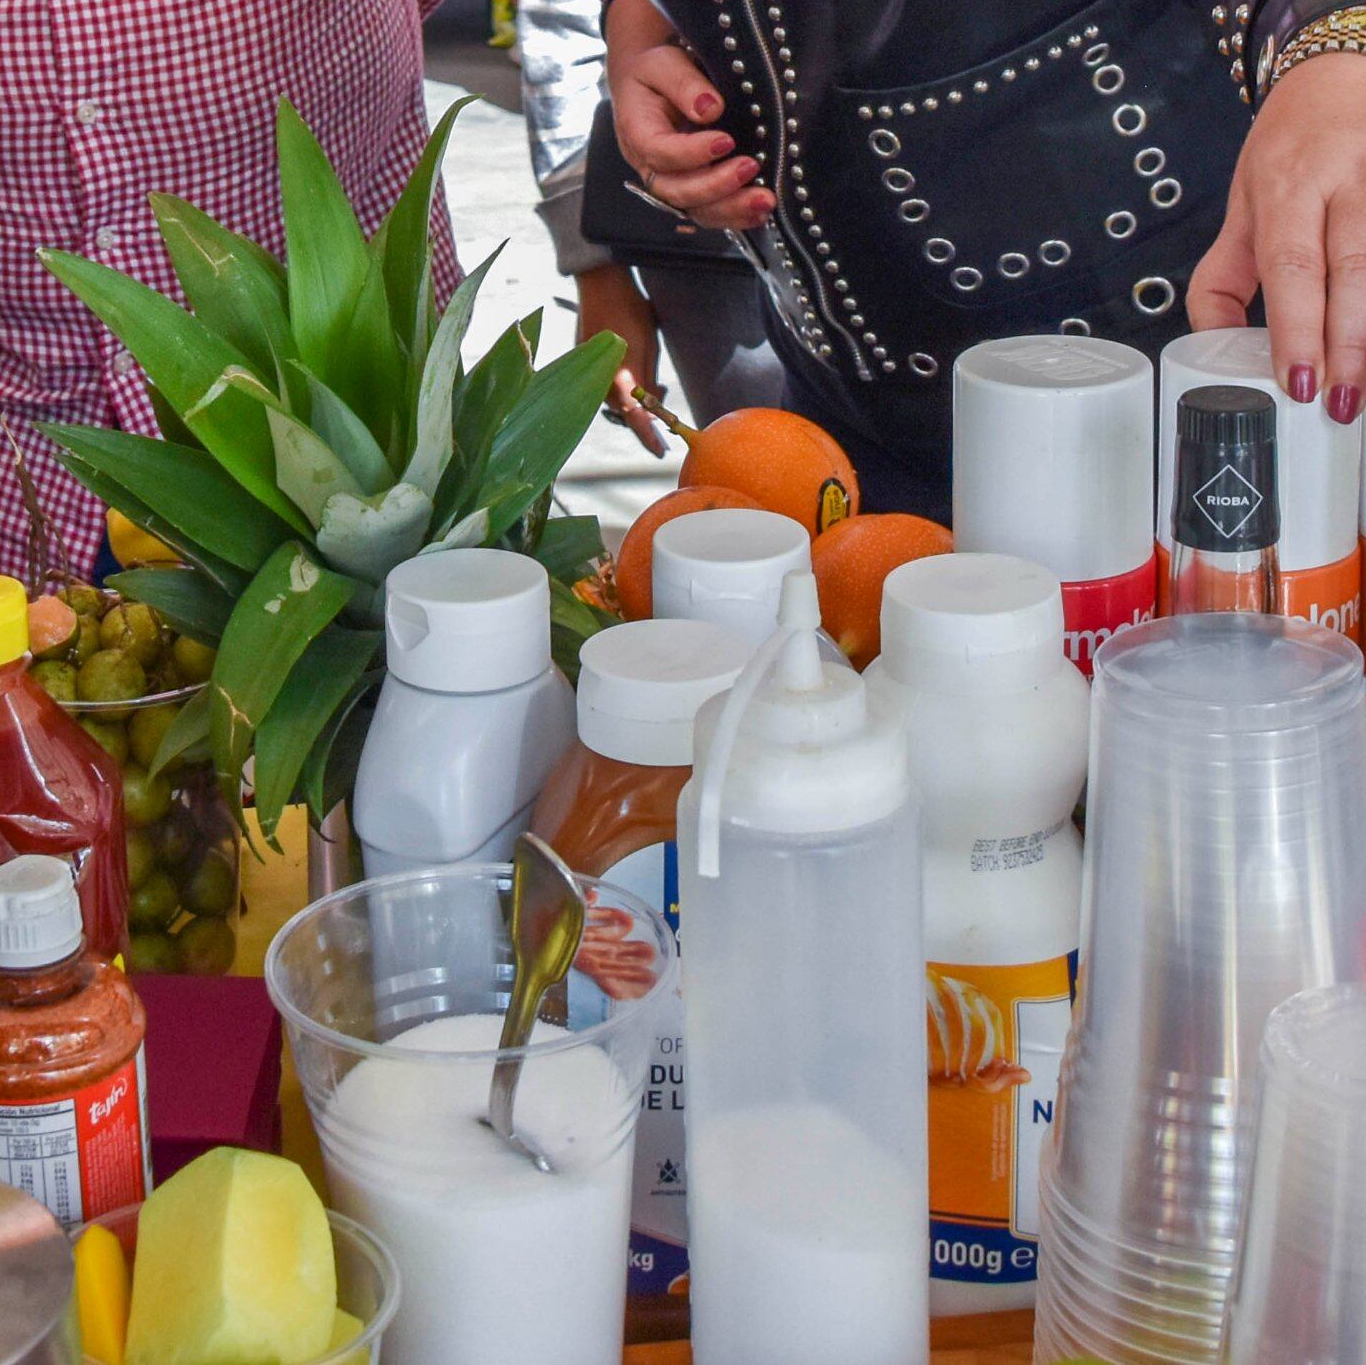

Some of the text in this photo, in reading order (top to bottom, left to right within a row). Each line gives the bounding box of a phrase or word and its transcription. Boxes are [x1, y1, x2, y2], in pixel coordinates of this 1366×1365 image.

[1206, 495, 1250, 506] RIOBA
[973, 839, 997, 852] BEST
[998, 835, 1029, 852] BEFORE
[88, 1078, 128, 1126] tajín
